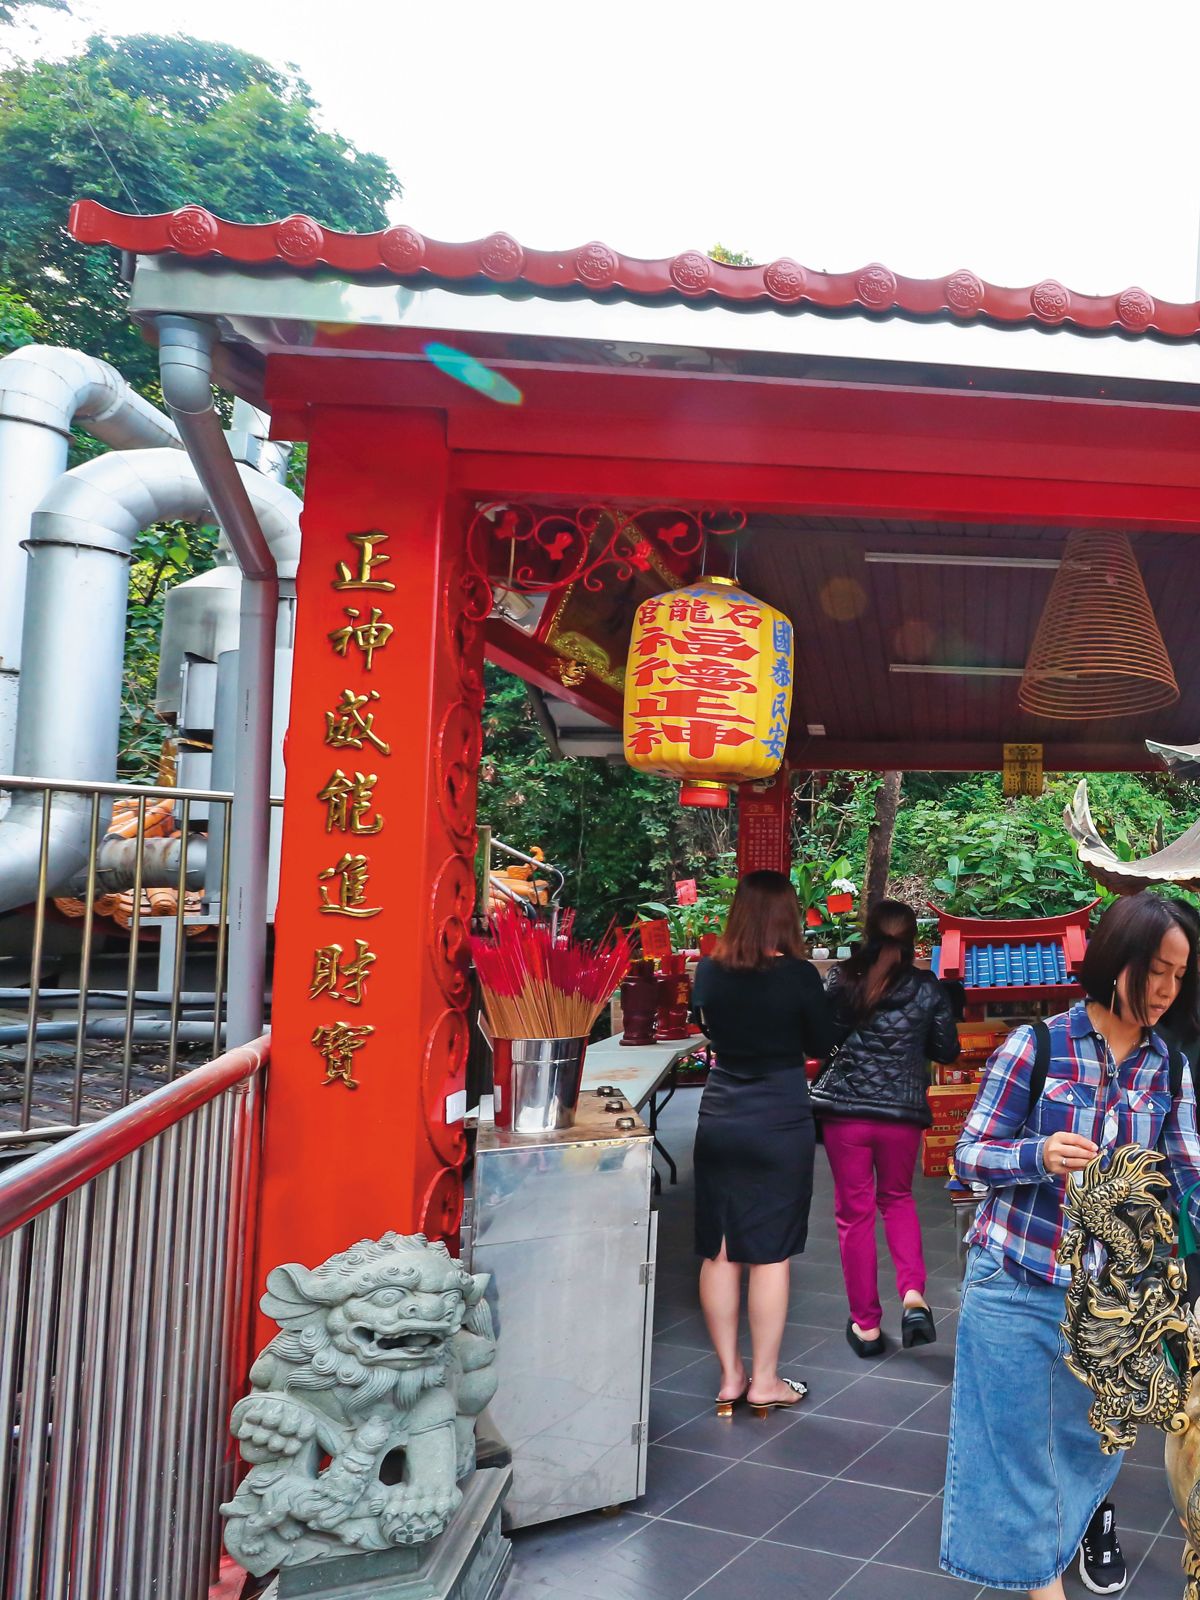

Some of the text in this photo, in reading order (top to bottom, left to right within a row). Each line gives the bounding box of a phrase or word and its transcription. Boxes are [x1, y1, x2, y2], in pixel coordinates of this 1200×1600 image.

[627, 625, 761, 760] 福德正神
[761, 620, 793, 760] 國泰民安
